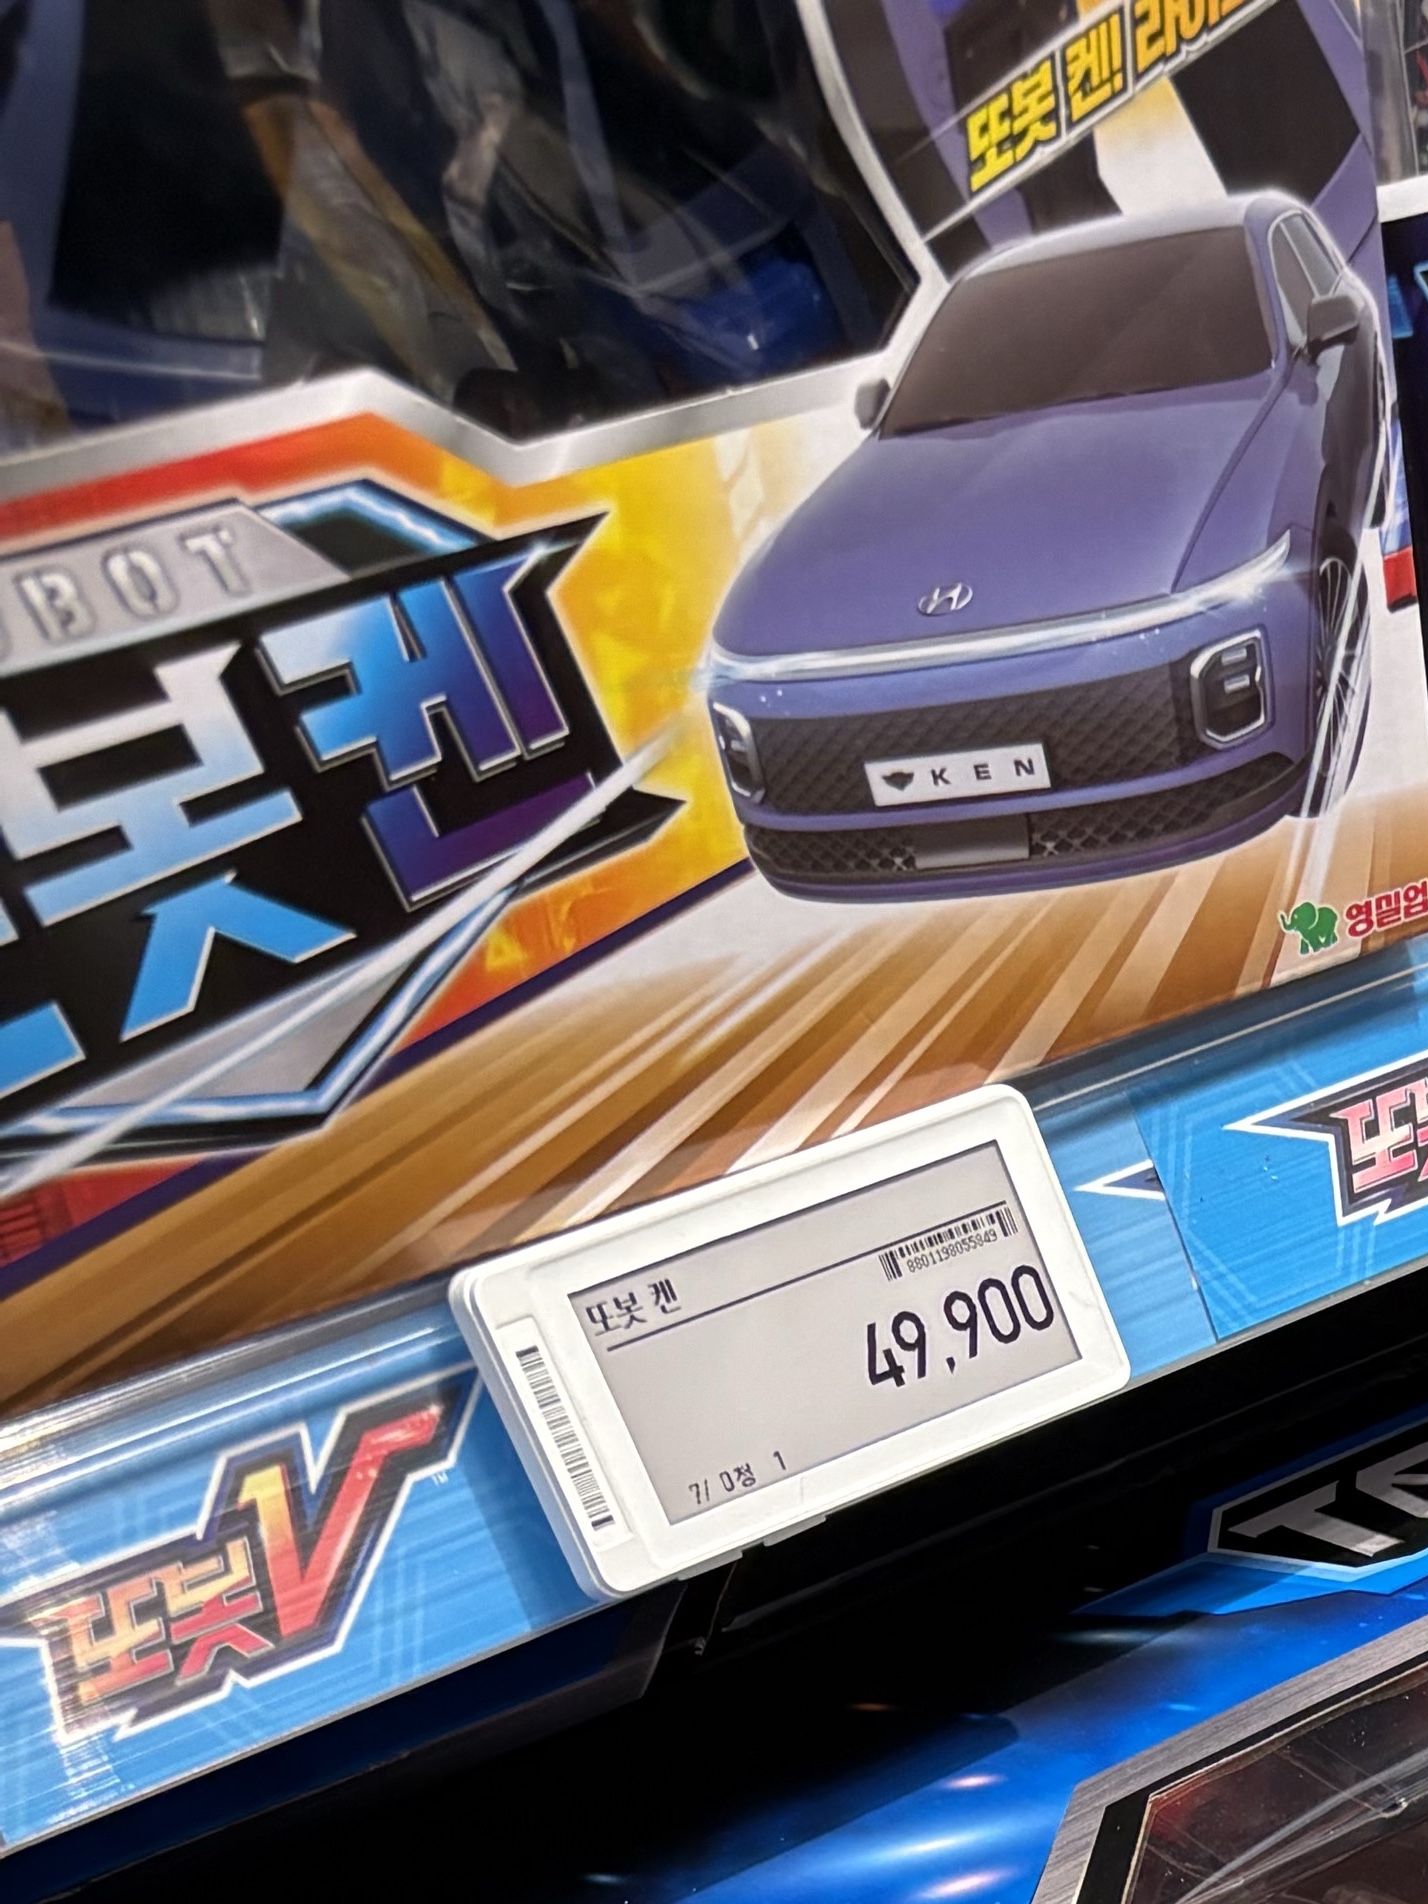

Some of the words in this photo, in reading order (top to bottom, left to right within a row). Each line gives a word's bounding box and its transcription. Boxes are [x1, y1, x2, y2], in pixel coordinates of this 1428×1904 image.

[966, 57, 1056, 192] 또봇
[1066, 15, 1123, 123] 켄!
[1135, 0, 1246, 72] 라이
[0, 522, 255, 648] BOT
[931, 757, 1036, 787] KEN
[905, 1228, 1000, 1275] 8801198055849
[586, 1281, 648, 1337] 또봇
[647, 1277, 683, 1314] 켄
[866, 1264, 1056, 1388] 49,900
